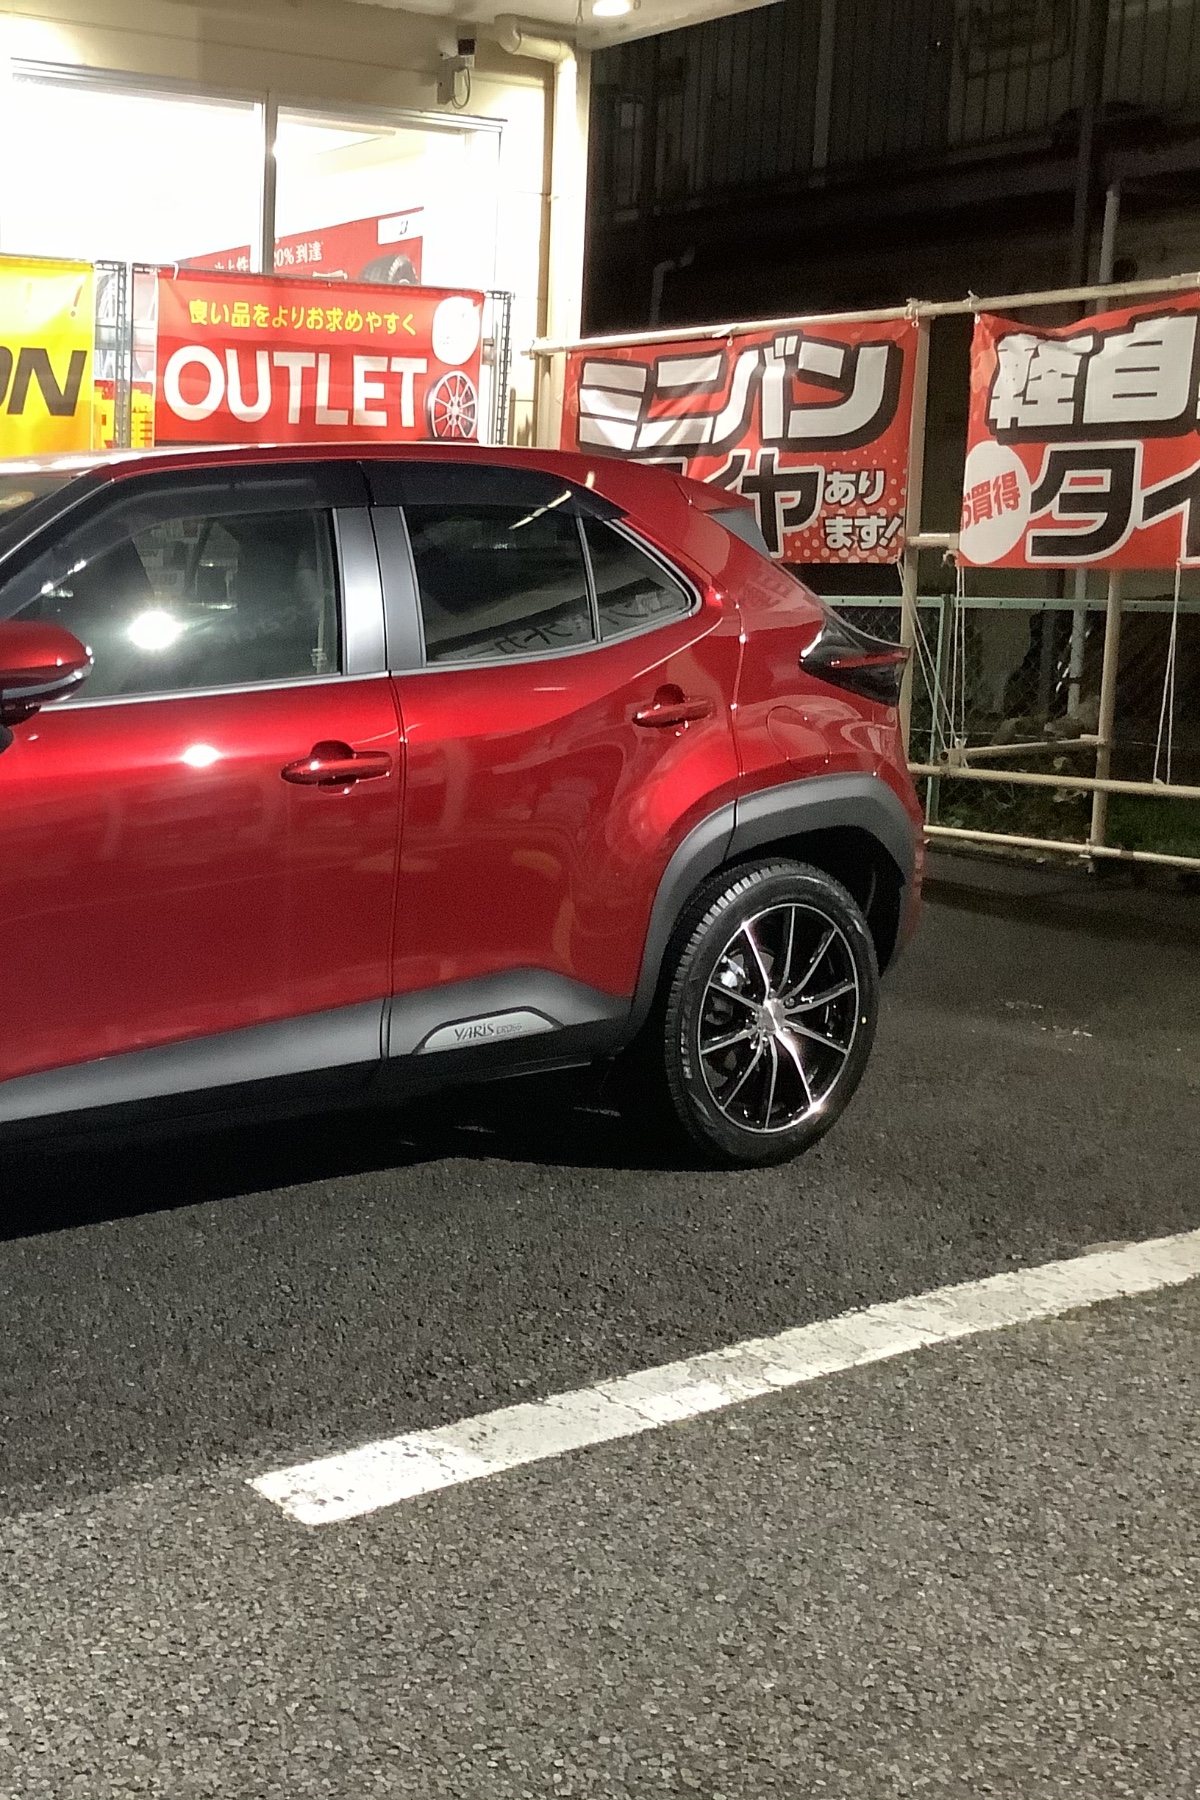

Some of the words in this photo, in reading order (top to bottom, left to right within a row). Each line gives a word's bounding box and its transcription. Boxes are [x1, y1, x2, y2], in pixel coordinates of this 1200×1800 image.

[274, 241, 322, 268] 0%到達
[189, 299, 417, 336] 良い品をよりお求めやすく
[163, 345, 428, 428] OUTLET
[988, 314, 1200, 430] 軽自
[577, 334, 892, 450] ミニバン
[824, 470, 885, 506] あり
[454, 1022, 495, 1041] YARIS
